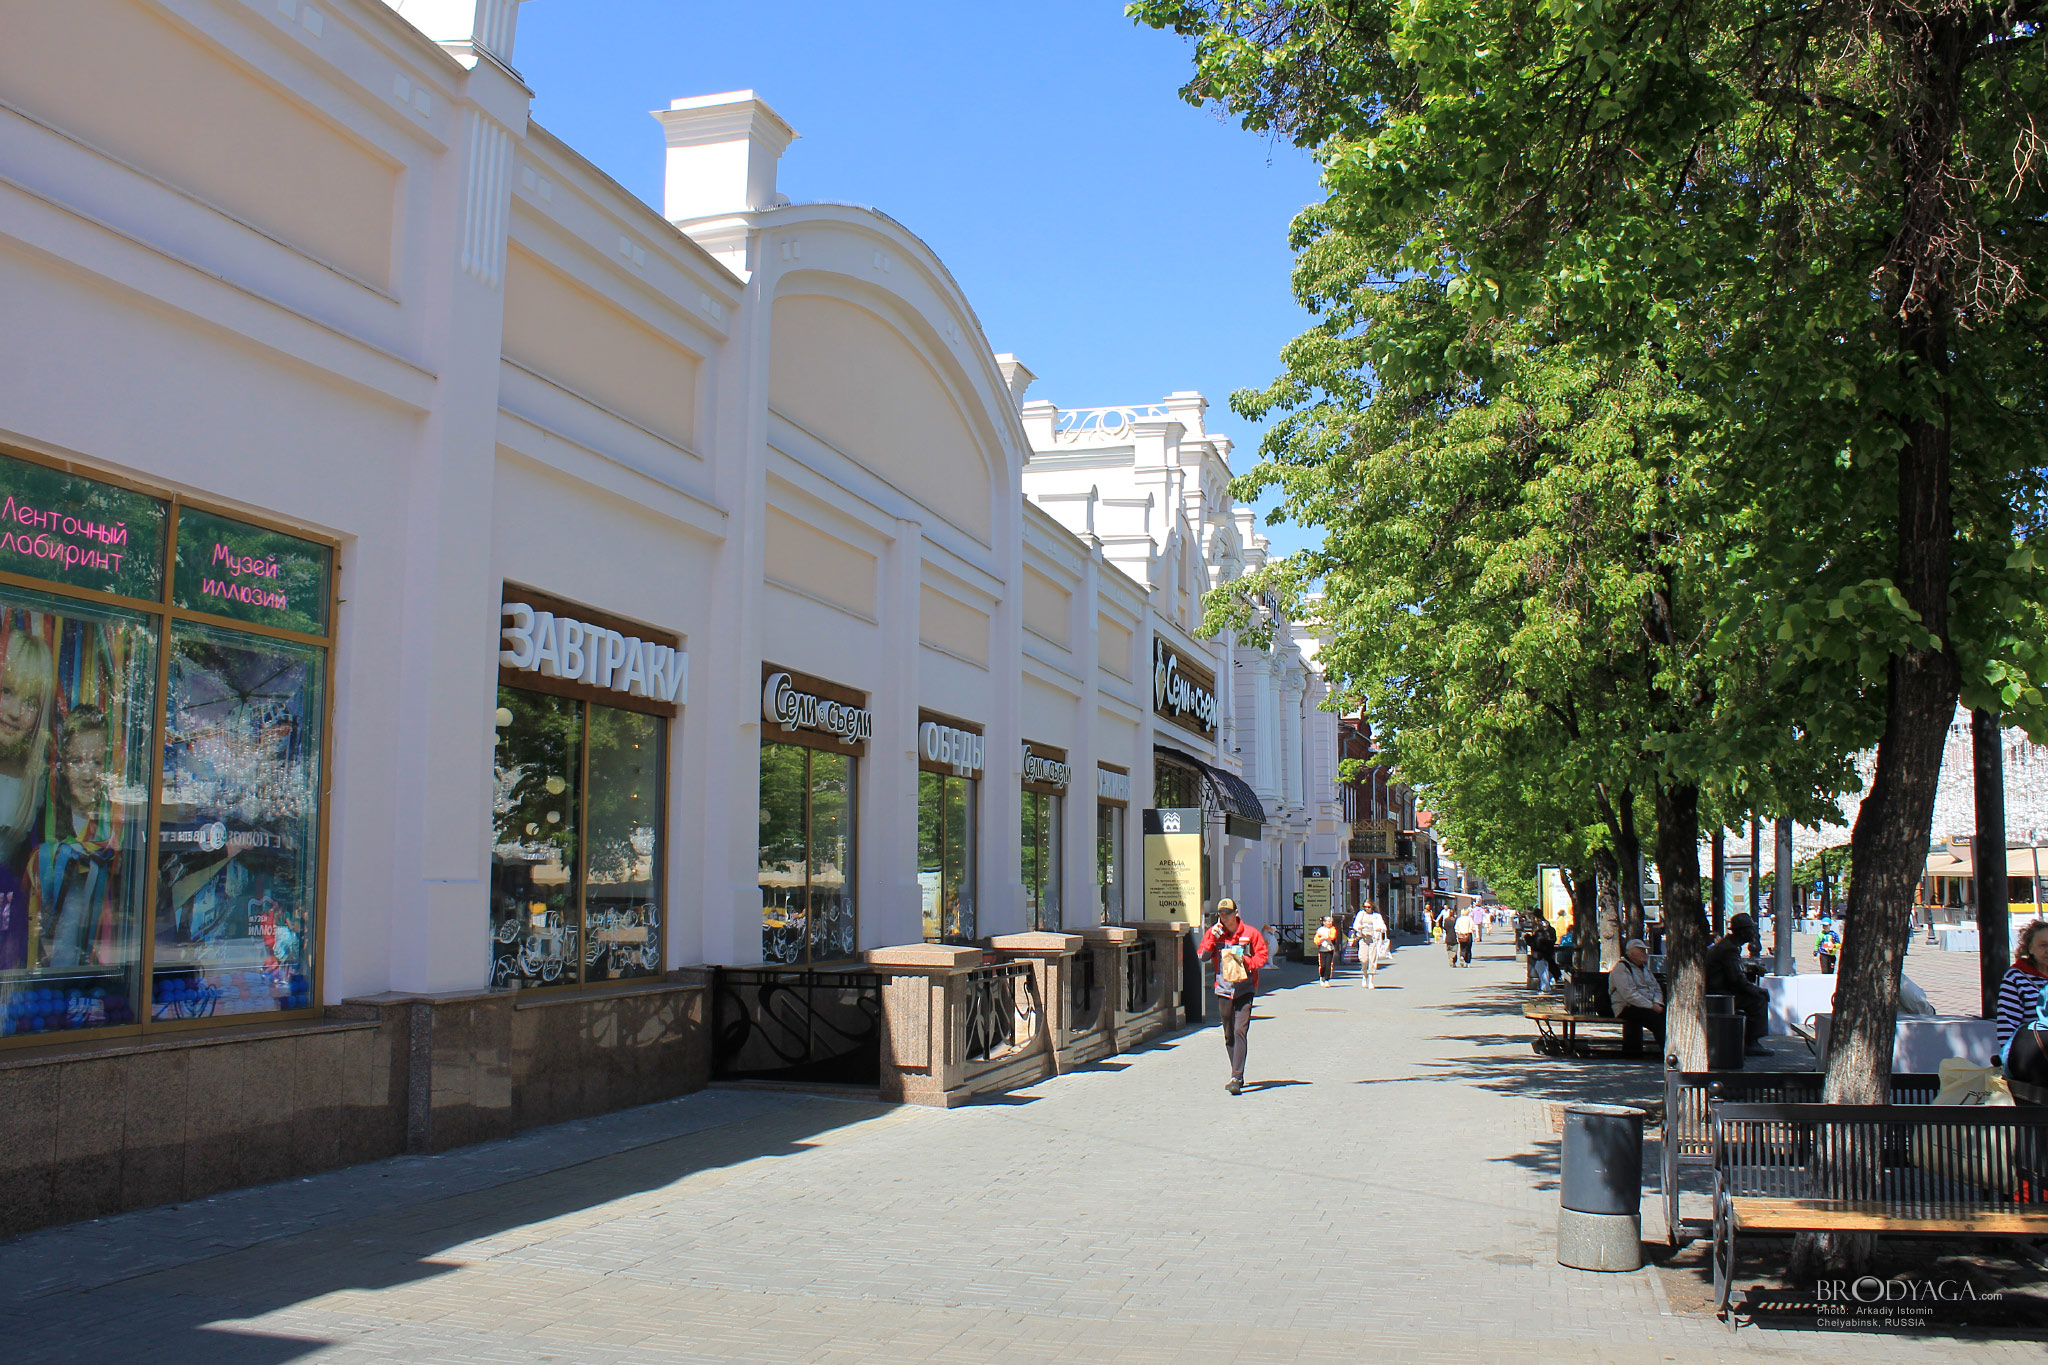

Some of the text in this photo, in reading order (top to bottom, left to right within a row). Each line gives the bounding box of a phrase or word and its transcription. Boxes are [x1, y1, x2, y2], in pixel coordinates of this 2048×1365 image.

[1, 496, 127, 547] Ленточный
[0, 532, 124, 572] лабиринт
[211, 543, 279, 580] Музей
[203, 577, 288, 611] иллюзий
[500, 602, 689, 705] ЗАВТРАКИ
[764, 673, 872, 744] Сели съели
[1167, 654, 1191, 716] Сели
[919, 721, 985, 777] ОБЕДЫ
[1022, 745, 1044, 783] Сели
